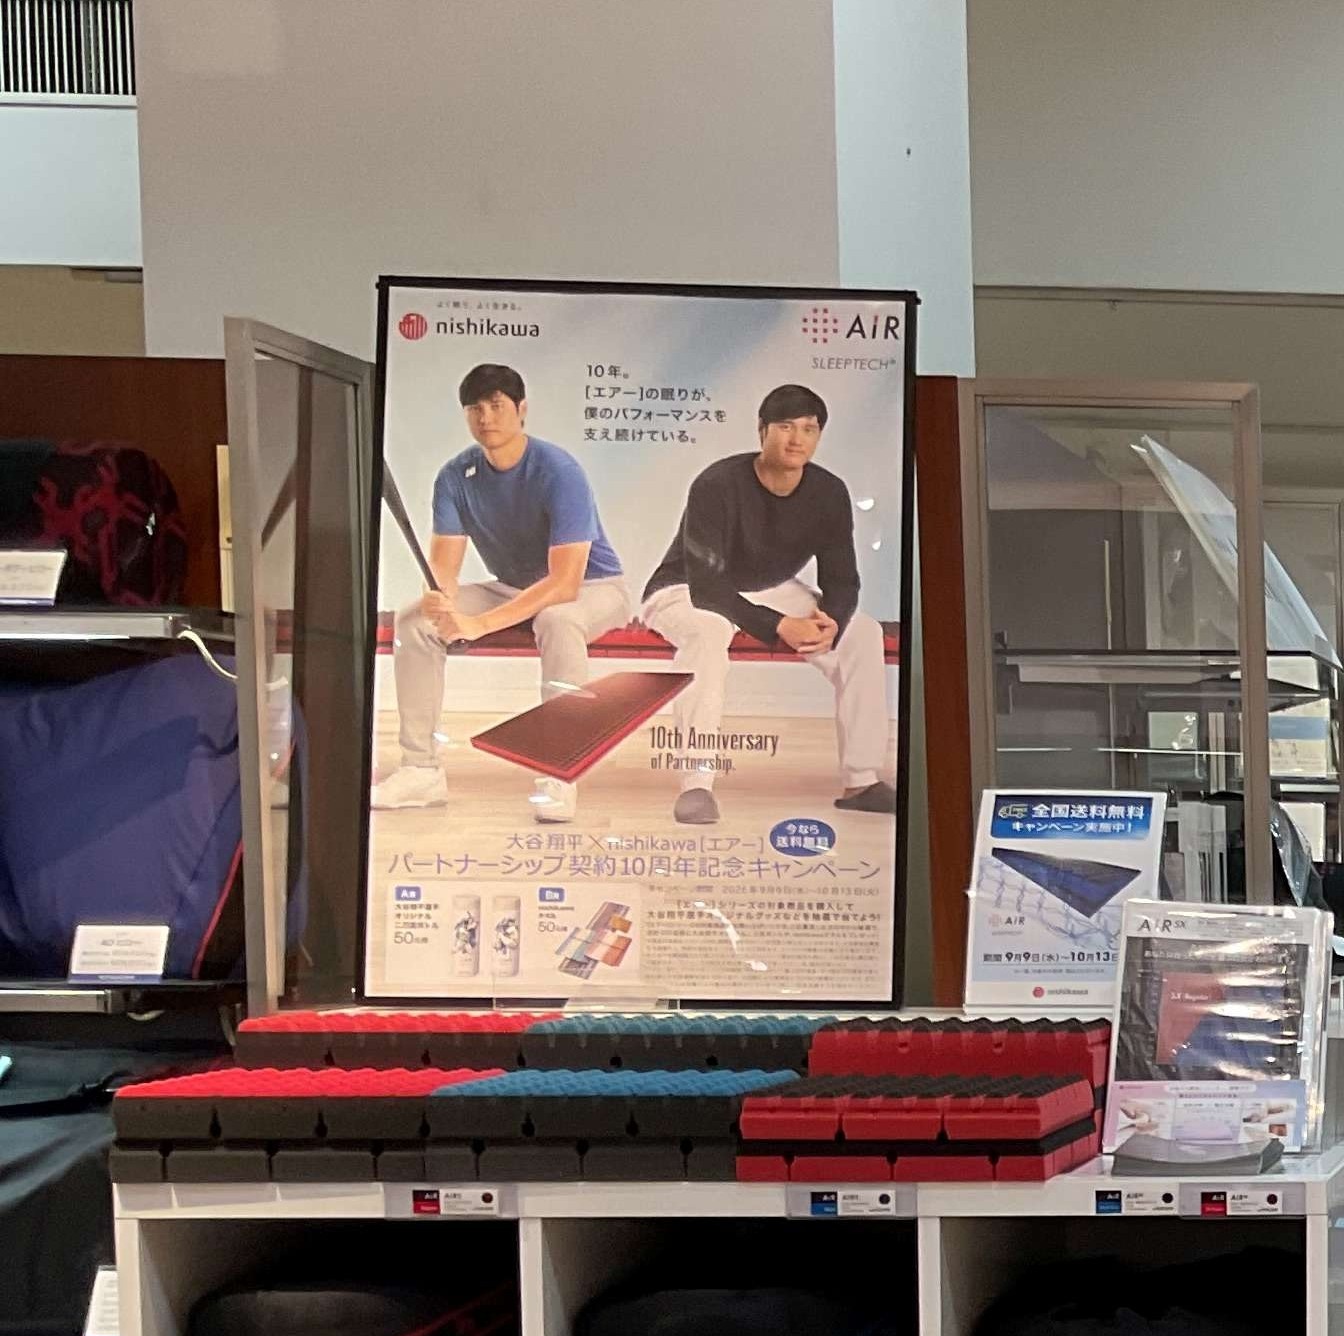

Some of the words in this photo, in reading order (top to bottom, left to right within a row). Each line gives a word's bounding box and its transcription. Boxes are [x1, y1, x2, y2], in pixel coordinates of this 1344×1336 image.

[436, 317, 540, 338] nishikawa
[586, 364, 630, 379] 10年。
[584, 406, 727, 423] 僕のパフォーマンスを
[583, 427, 697, 444] 支え続けている。
[650, 725, 683, 749] 10th
[687, 725, 779, 757] Anniversary
[650, 752, 663, 770] of
[1031, 803, 1145, 820] 全国送料無料
